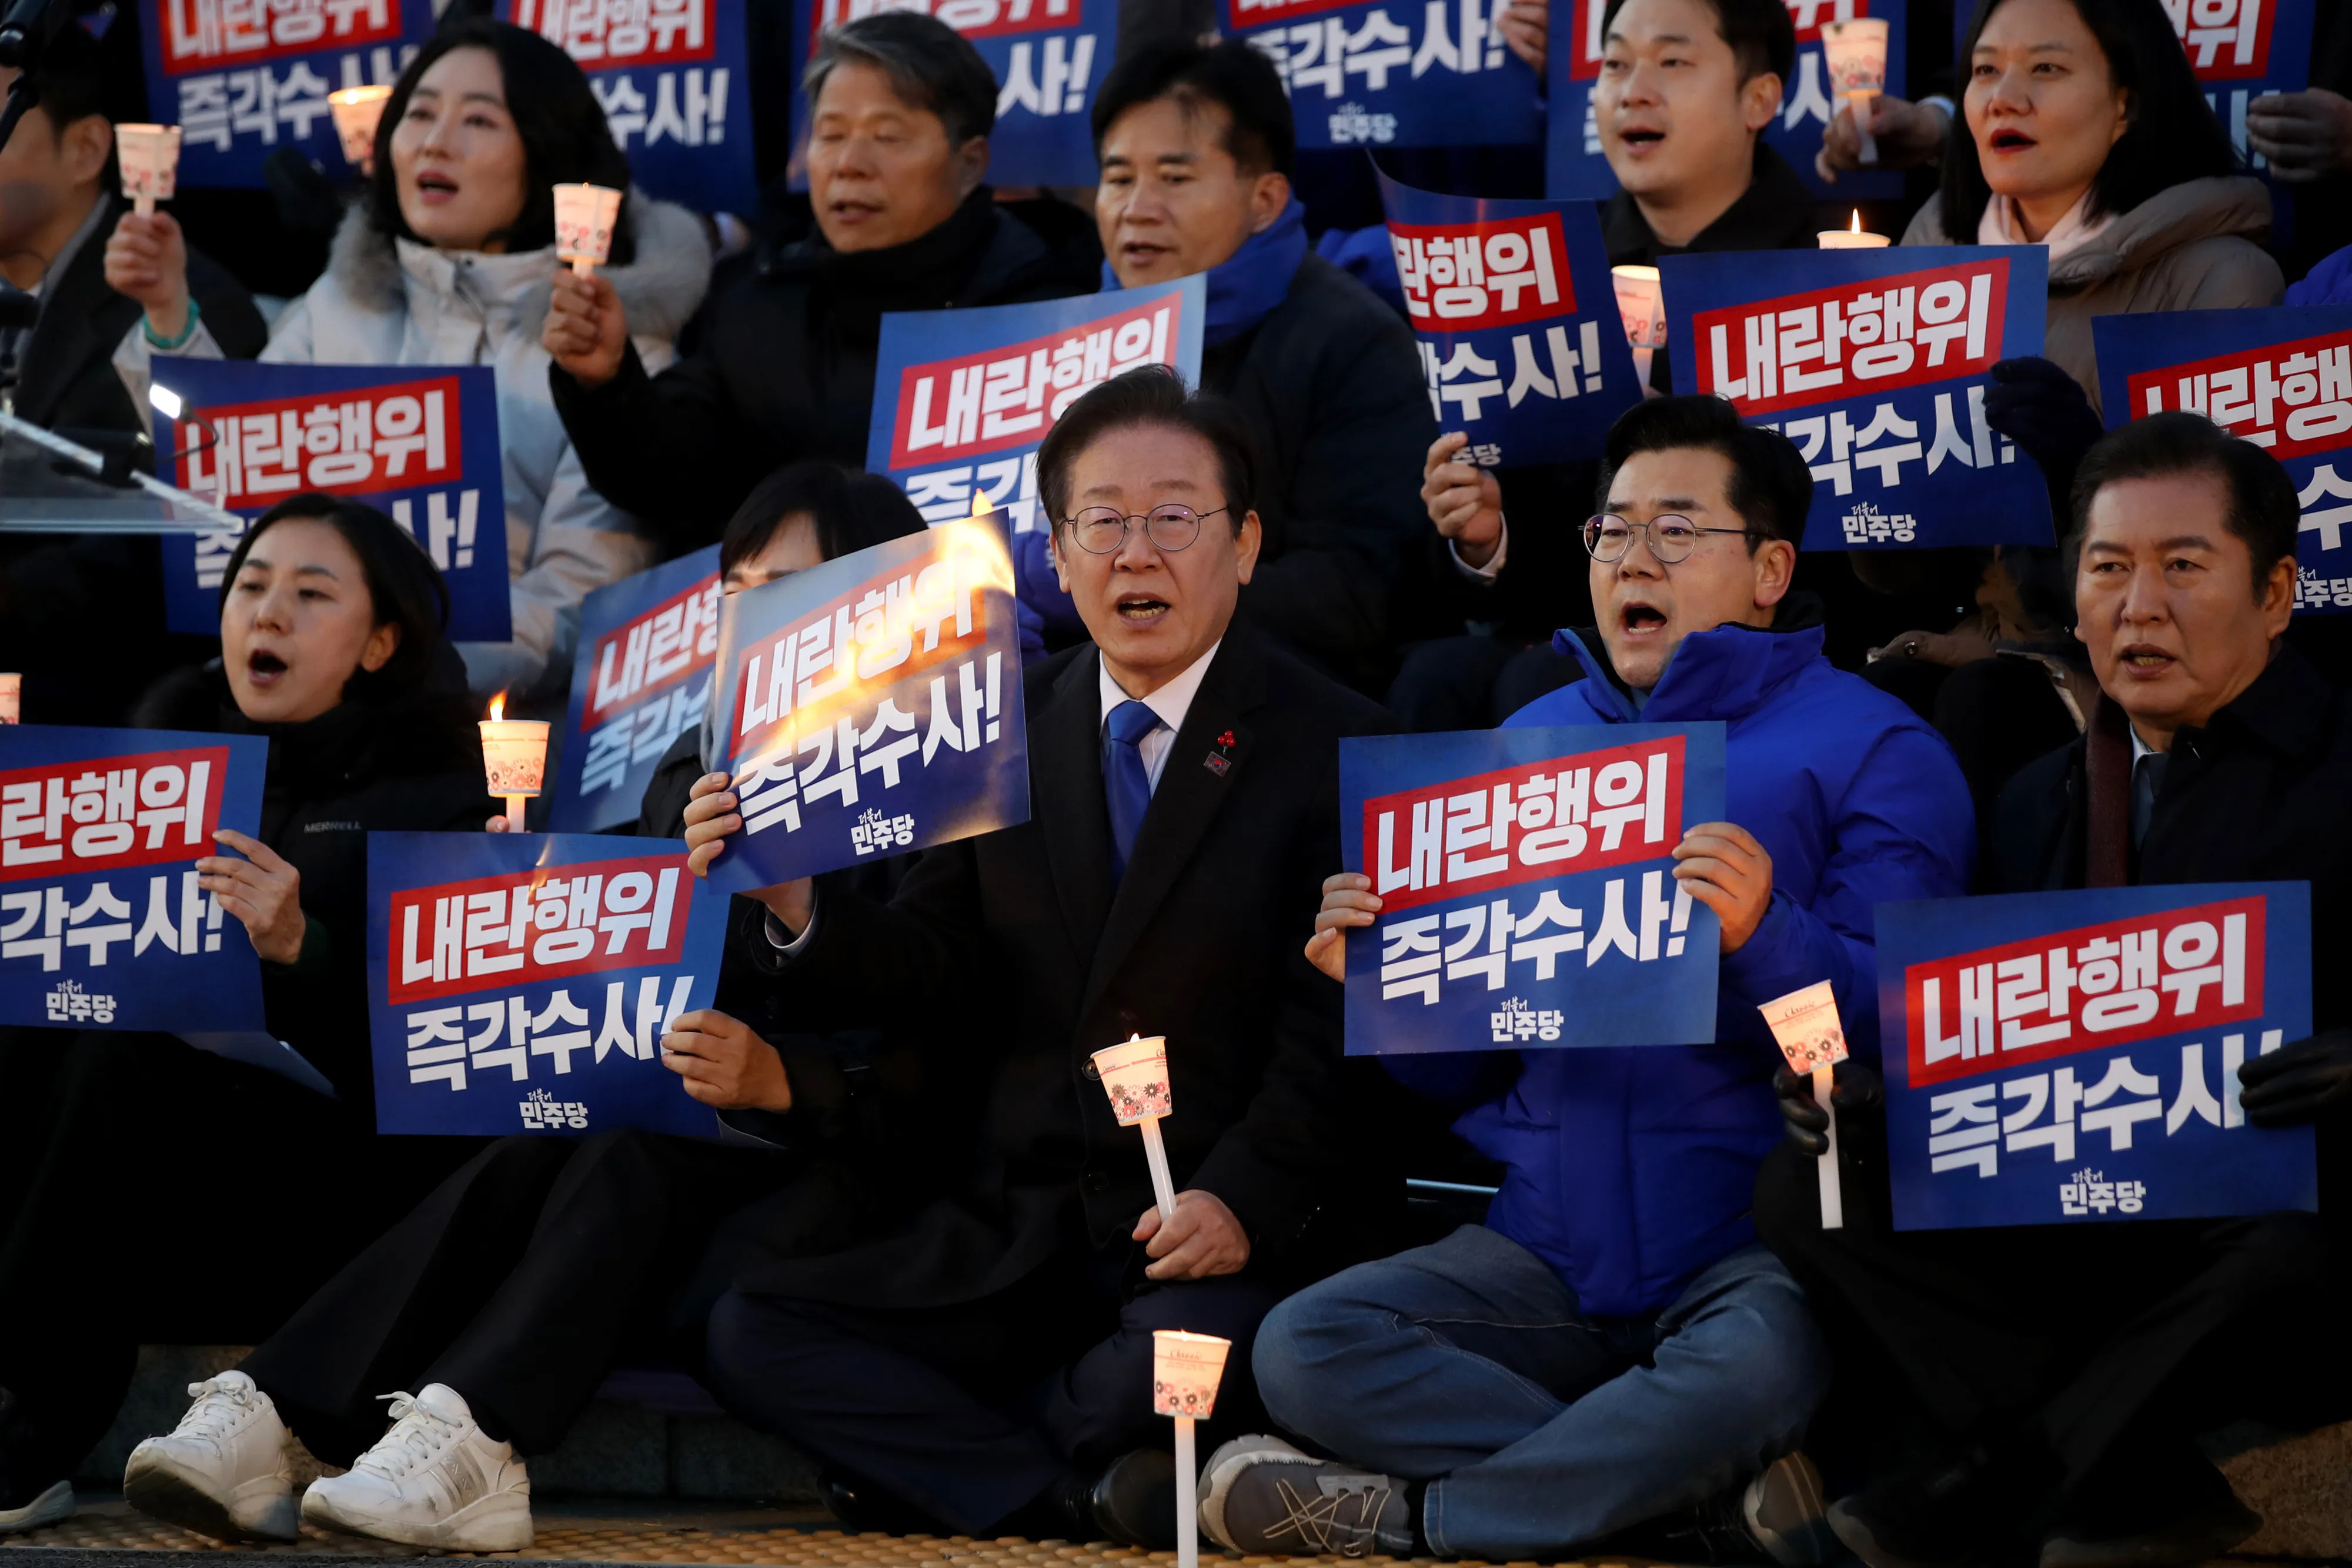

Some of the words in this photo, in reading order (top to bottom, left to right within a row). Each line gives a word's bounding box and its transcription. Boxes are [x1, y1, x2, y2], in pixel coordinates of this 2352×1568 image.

[590, 68, 730, 152] 수사!
[1389, 226, 1559, 319] 란행위
[1416, 320, 1603, 422] 수사!
[1710, 273, 1992, 401] 내란행위
[186, 389, 446, 496] 내란행위
[1450, 443, 1502, 466] 주당
[1766, 385, 2015, 496] 각수사
[1842, 514, 1917, 543] 민주당
[1851, 502, 1878, 517] 더불어
[2298, 566, 2317, 583] 불어
[741, 548, 973, 736] 내란행위
[739, 651, 1001, 835] 즉각수사!
[1, 761, 211, 867] 란행위
[851, 814, 915, 855] 민주당
[858, 808, 883, 824] 더불어
[1378, 753, 1668, 896] 내란행위
[1, 870, 225, 972] 각수사!
[402, 867, 680, 985] 내란행위
[1380, 870, 1693, 1006] 즉각수사!
[46, 992, 116, 1024] 민주당
[56, 978, 82, 994] 더불어
[1491, 1009, 1564, 1042] 민주당
[1501, 997, 1528, 1012] 더불어
[1923, 913, 2247, 1066] 내란행위
[519, 1101, 588, 1129] 민주당
[527, 1088, 552, 1103] 더불어
[1929, 1029, 2283, 1178] 즉각수사
[2060, 1181, 2146, 1215] 민주당
